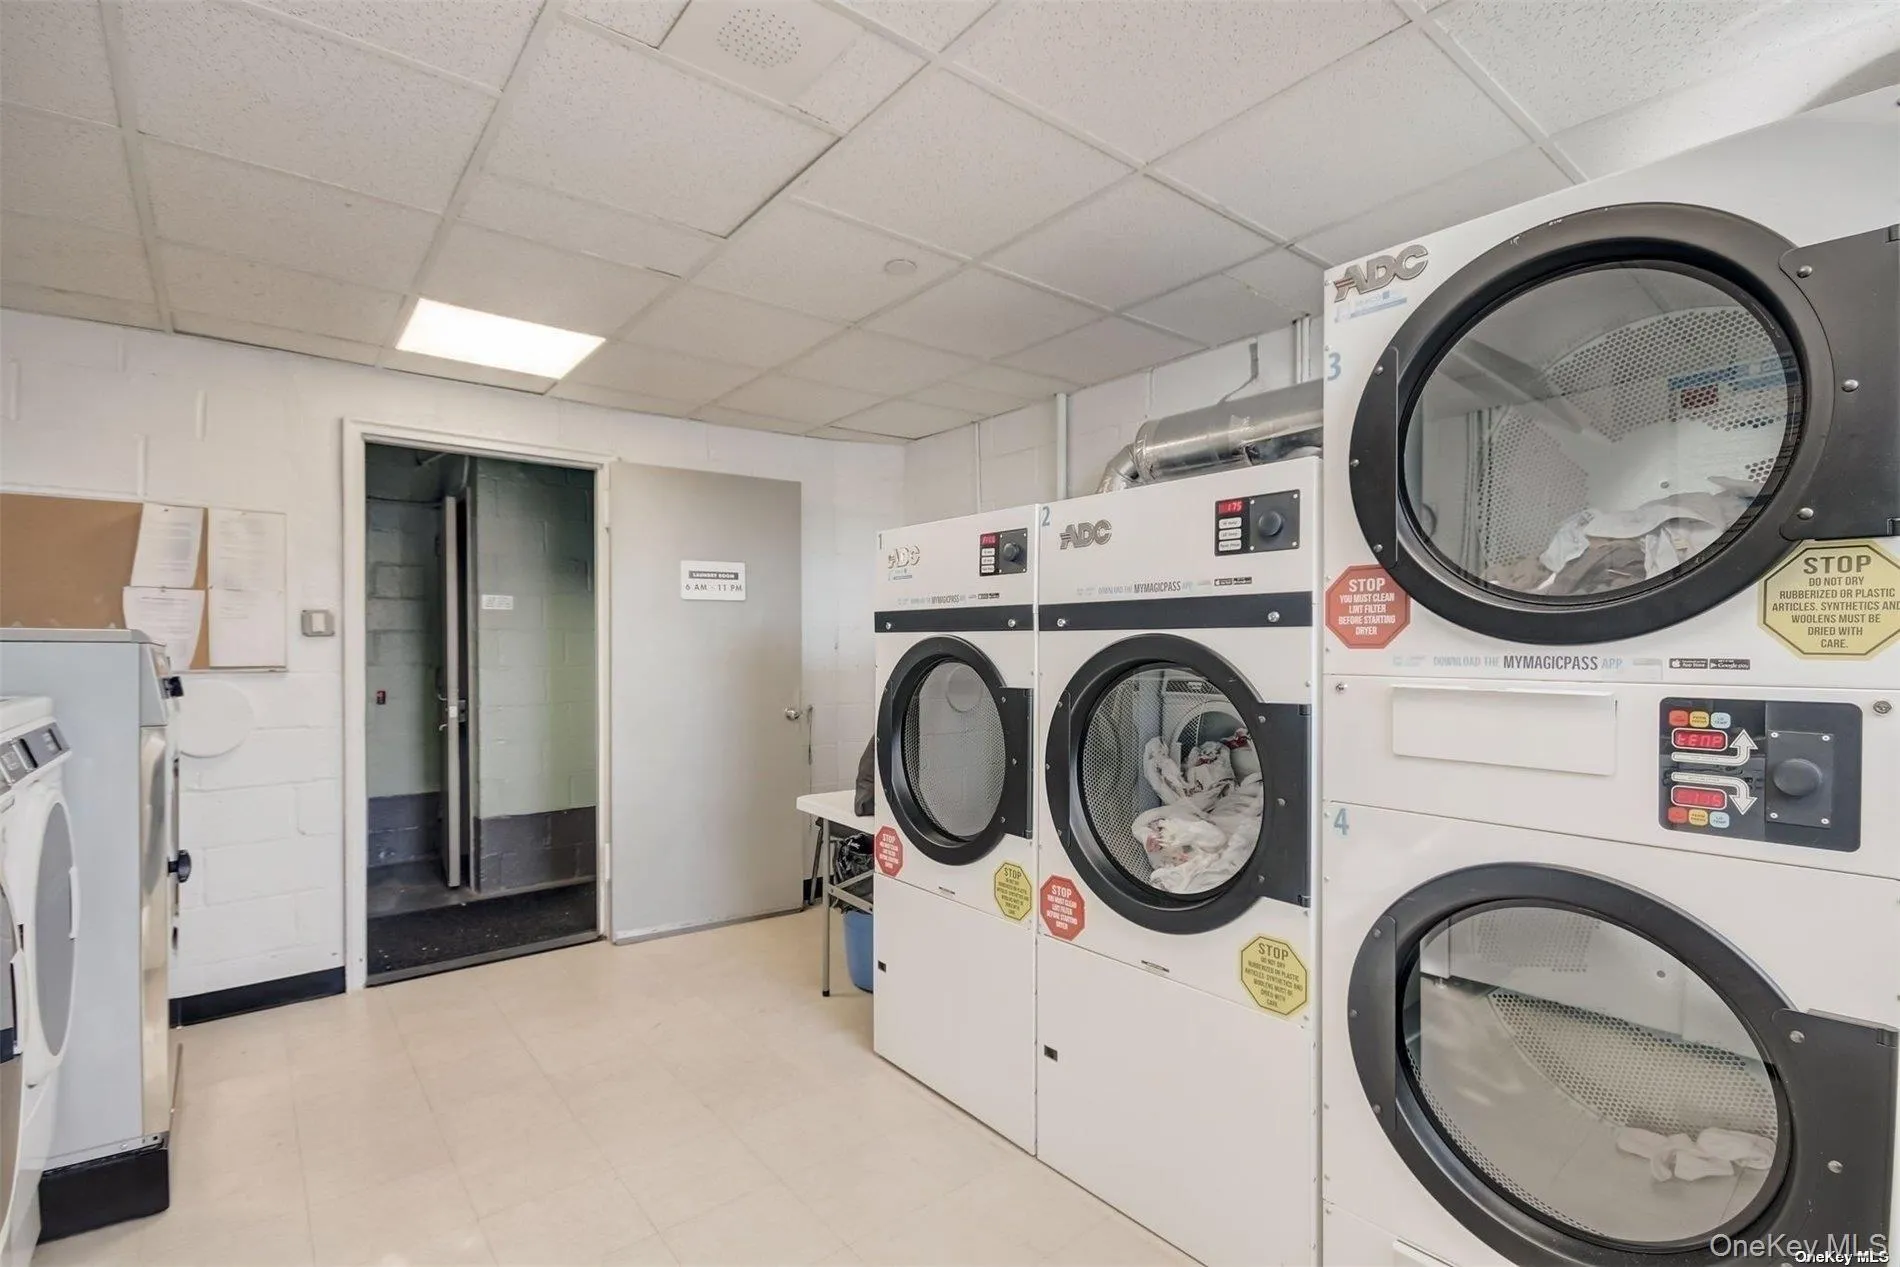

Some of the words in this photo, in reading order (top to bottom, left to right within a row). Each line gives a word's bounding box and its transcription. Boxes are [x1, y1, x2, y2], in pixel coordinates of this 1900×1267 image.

[1333, 244, 1429, 303] ADC
[1327, 352, 1341, 381] 3
[1042, 506, 1050, 527] 2
[1060, 519, 1112, 550] ADC
[878, 533, 883, 549] 1
[1803, 554, 1872, 574] STOP
[1349, 578, 1385, 592] STOP
[1808, 577, 1821, 586] DO
[1824, 577, 1842, 586] NOT
[1845, 576, 1864, 586] DRY
[730, 584, 743, 592] PM
[1779, 589, 1837, 599] RUBBERIZED
[1840, 589, 1853, 598] OR
[1855, 588, 1895, 598] PLASTIC
[1340, 594, 1353, 603] YOU
[1353, 593, 1371, 603] MUST
[1373, 592, 1395, 602] CLEAN
[1364, 604, 1386, 613] FILTER
[1820, 601, 1880, 611] SYNTHETICS
[1338, 616, 1363, 625] BEFORE
[1791, 614, 1836, 623] WOOLENS
[1838, 614, 1866, 623] MUST
[1868, 613, 1881, 623] BE
[1355, 626, 1378, 635] DRYER
[1808, 626, 1836, 636] DRIED
[1838, 626, 1863, 635] WITH
[1503, 655, 1598, 670] MYMAGICPASS
[1601, 657, 1624, 669] APP
[1334, 808, 1349, 836] 4
[1004, 867, 1021, 879] STOP
[1052, 885, 1072, 898] STOP
[1258, 942, 1289, 960] STOP
